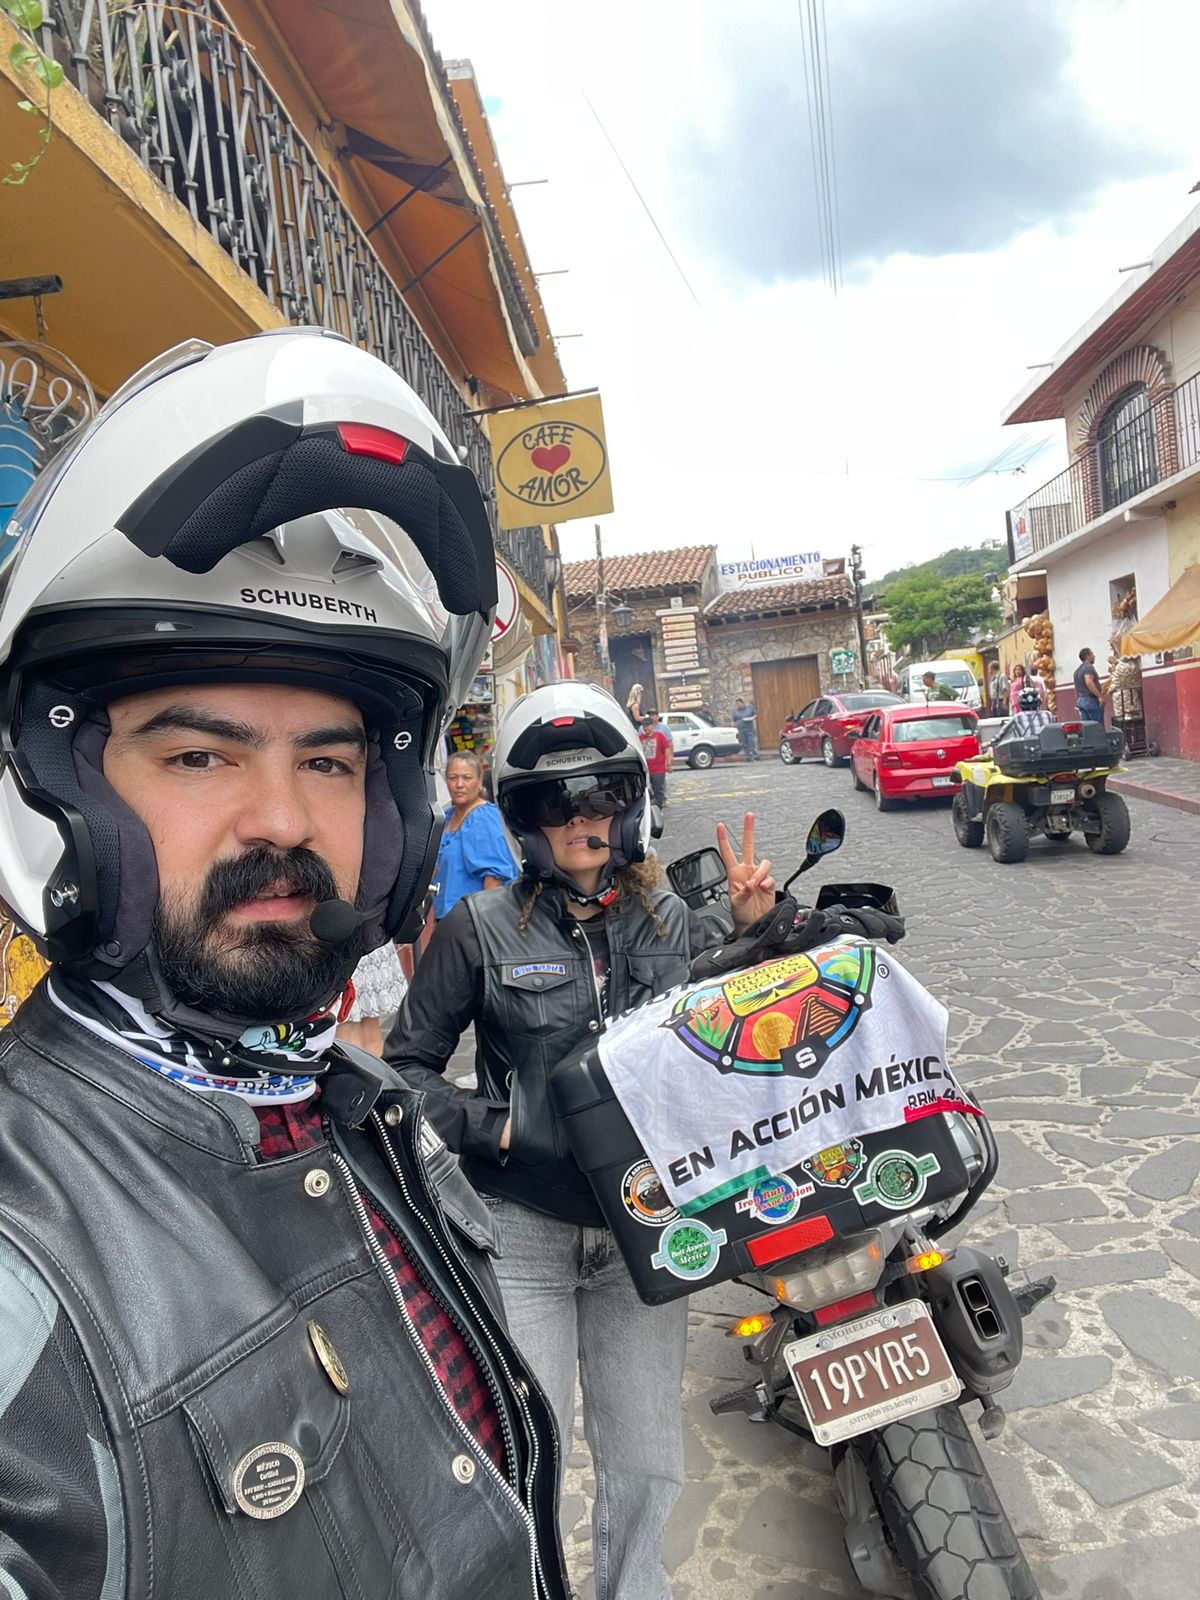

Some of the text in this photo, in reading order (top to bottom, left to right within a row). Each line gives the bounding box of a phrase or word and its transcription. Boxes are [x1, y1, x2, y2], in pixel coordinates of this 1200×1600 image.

[522, 426, 574, 450] CAFE
[518, 467, 588, 502] AMOR
[721, 552, 820, 575] ESTACIONAMIENTO
[738, 566, 803, 580] PUBLICO
[240, 588, 377, 623] SCHUBERTH
[546, 755, 592, 767] SCHUBERTH
[795, 1046, 817, 1069] S
[908, 1089, 937, 1109] RRM
[668, 1146, 716, 1188] EN
[730, 1083, 846, 1160] ACCIÓN
[625, 1174, 634, 1188] THE
[738, 1185, 786, 1211] Iron Butt
[755, 1185, 813, 1213] Association
[828, 1317, 881, 1341] MORELOS
[810, 1333, 930, 1411] 19PYR5
